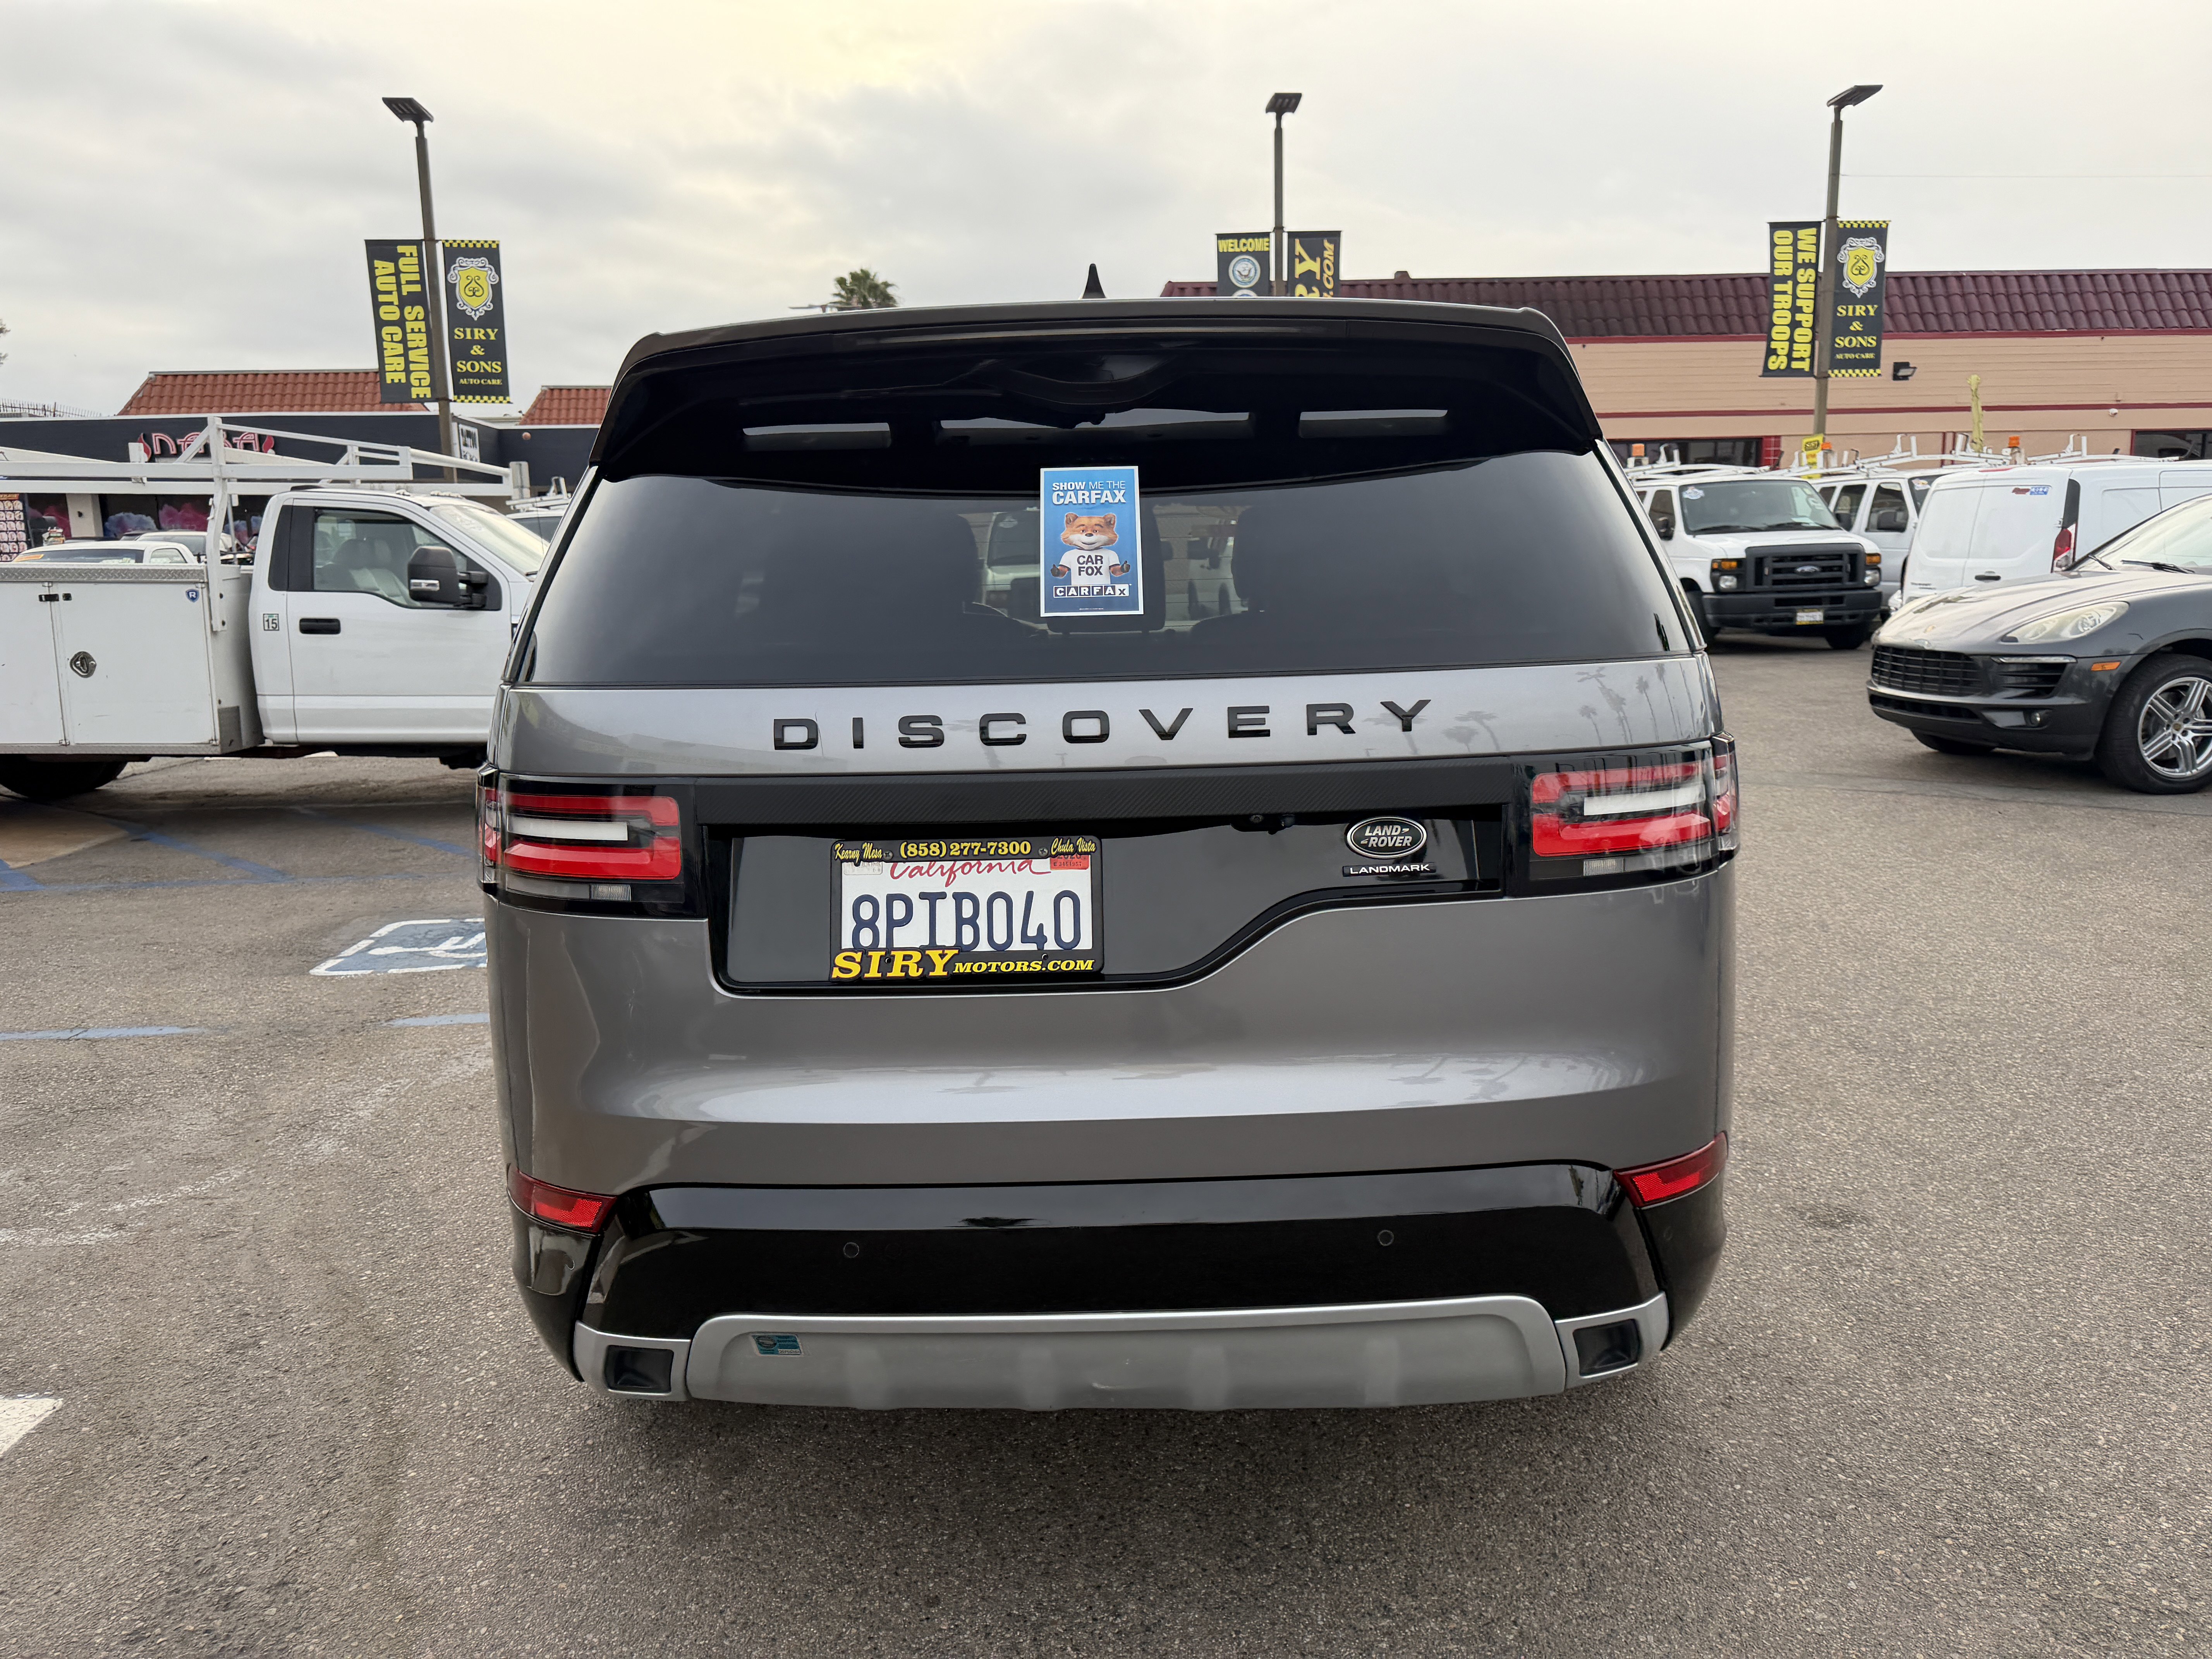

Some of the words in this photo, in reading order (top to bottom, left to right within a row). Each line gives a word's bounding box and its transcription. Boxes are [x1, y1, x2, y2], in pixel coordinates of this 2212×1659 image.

[1218, 237, 1269, 252] WELCOME
[1797, 228, 1817, 263] WE
[1773, 230, 1793, 276] OUR
[397, 245, 421, 295] FULL
[374, 260, 400, 321] AUTO
[1837, 305, 1879, 316] SIRY
[1768, 280, 1792, 370] TROOPS
[1791, 268, 1816, 372] SUPPORT
[1849, 321, 1863, 331] &
[454, 327, 498, 340] SIRY
[1835, 336, 1877, 348] SONS
[381, 326, 406, 384] CARE
[404, 306, 431, 399] SERVICE
[471, 345, 485, 355] &
[457, 361, 502, 373] SONS
[1052, 481, 1085, 491] SHOW
[1089, 481, 1104, 490] ME
[1106, 481, 1126, 489] THE
[1052, 489, 1126, 505] CARFAX
[1077, 555, 1103, 565] CAR
[1078, 566, 1103, 576] FOX
[1056, 586, 1127, 597] CARFAX
[266, 618, 277, 629] 15
[774, 699, 1431, 750] DISCOVERY
[1365, 825, 1401, 836] LAND
[1051, 838, 1074, 855] Chula
[1077, 837, 1096, 852] Vista
[1368, 836, 1412, 847] ROVER
[835, 843, 860, 864] Kearny
[862, 842, 883, 859] Mesa
[900, 841, 946, 859] (858)
[950, 841, 1031, 856] 277-7300
[890, 859, 1051, 887] California
[1350, 864, 1430, 874] LANDMARK
[831, 949, 958, 978] SIRY
[953, 960, 1094, 973] MOTORS.COM
